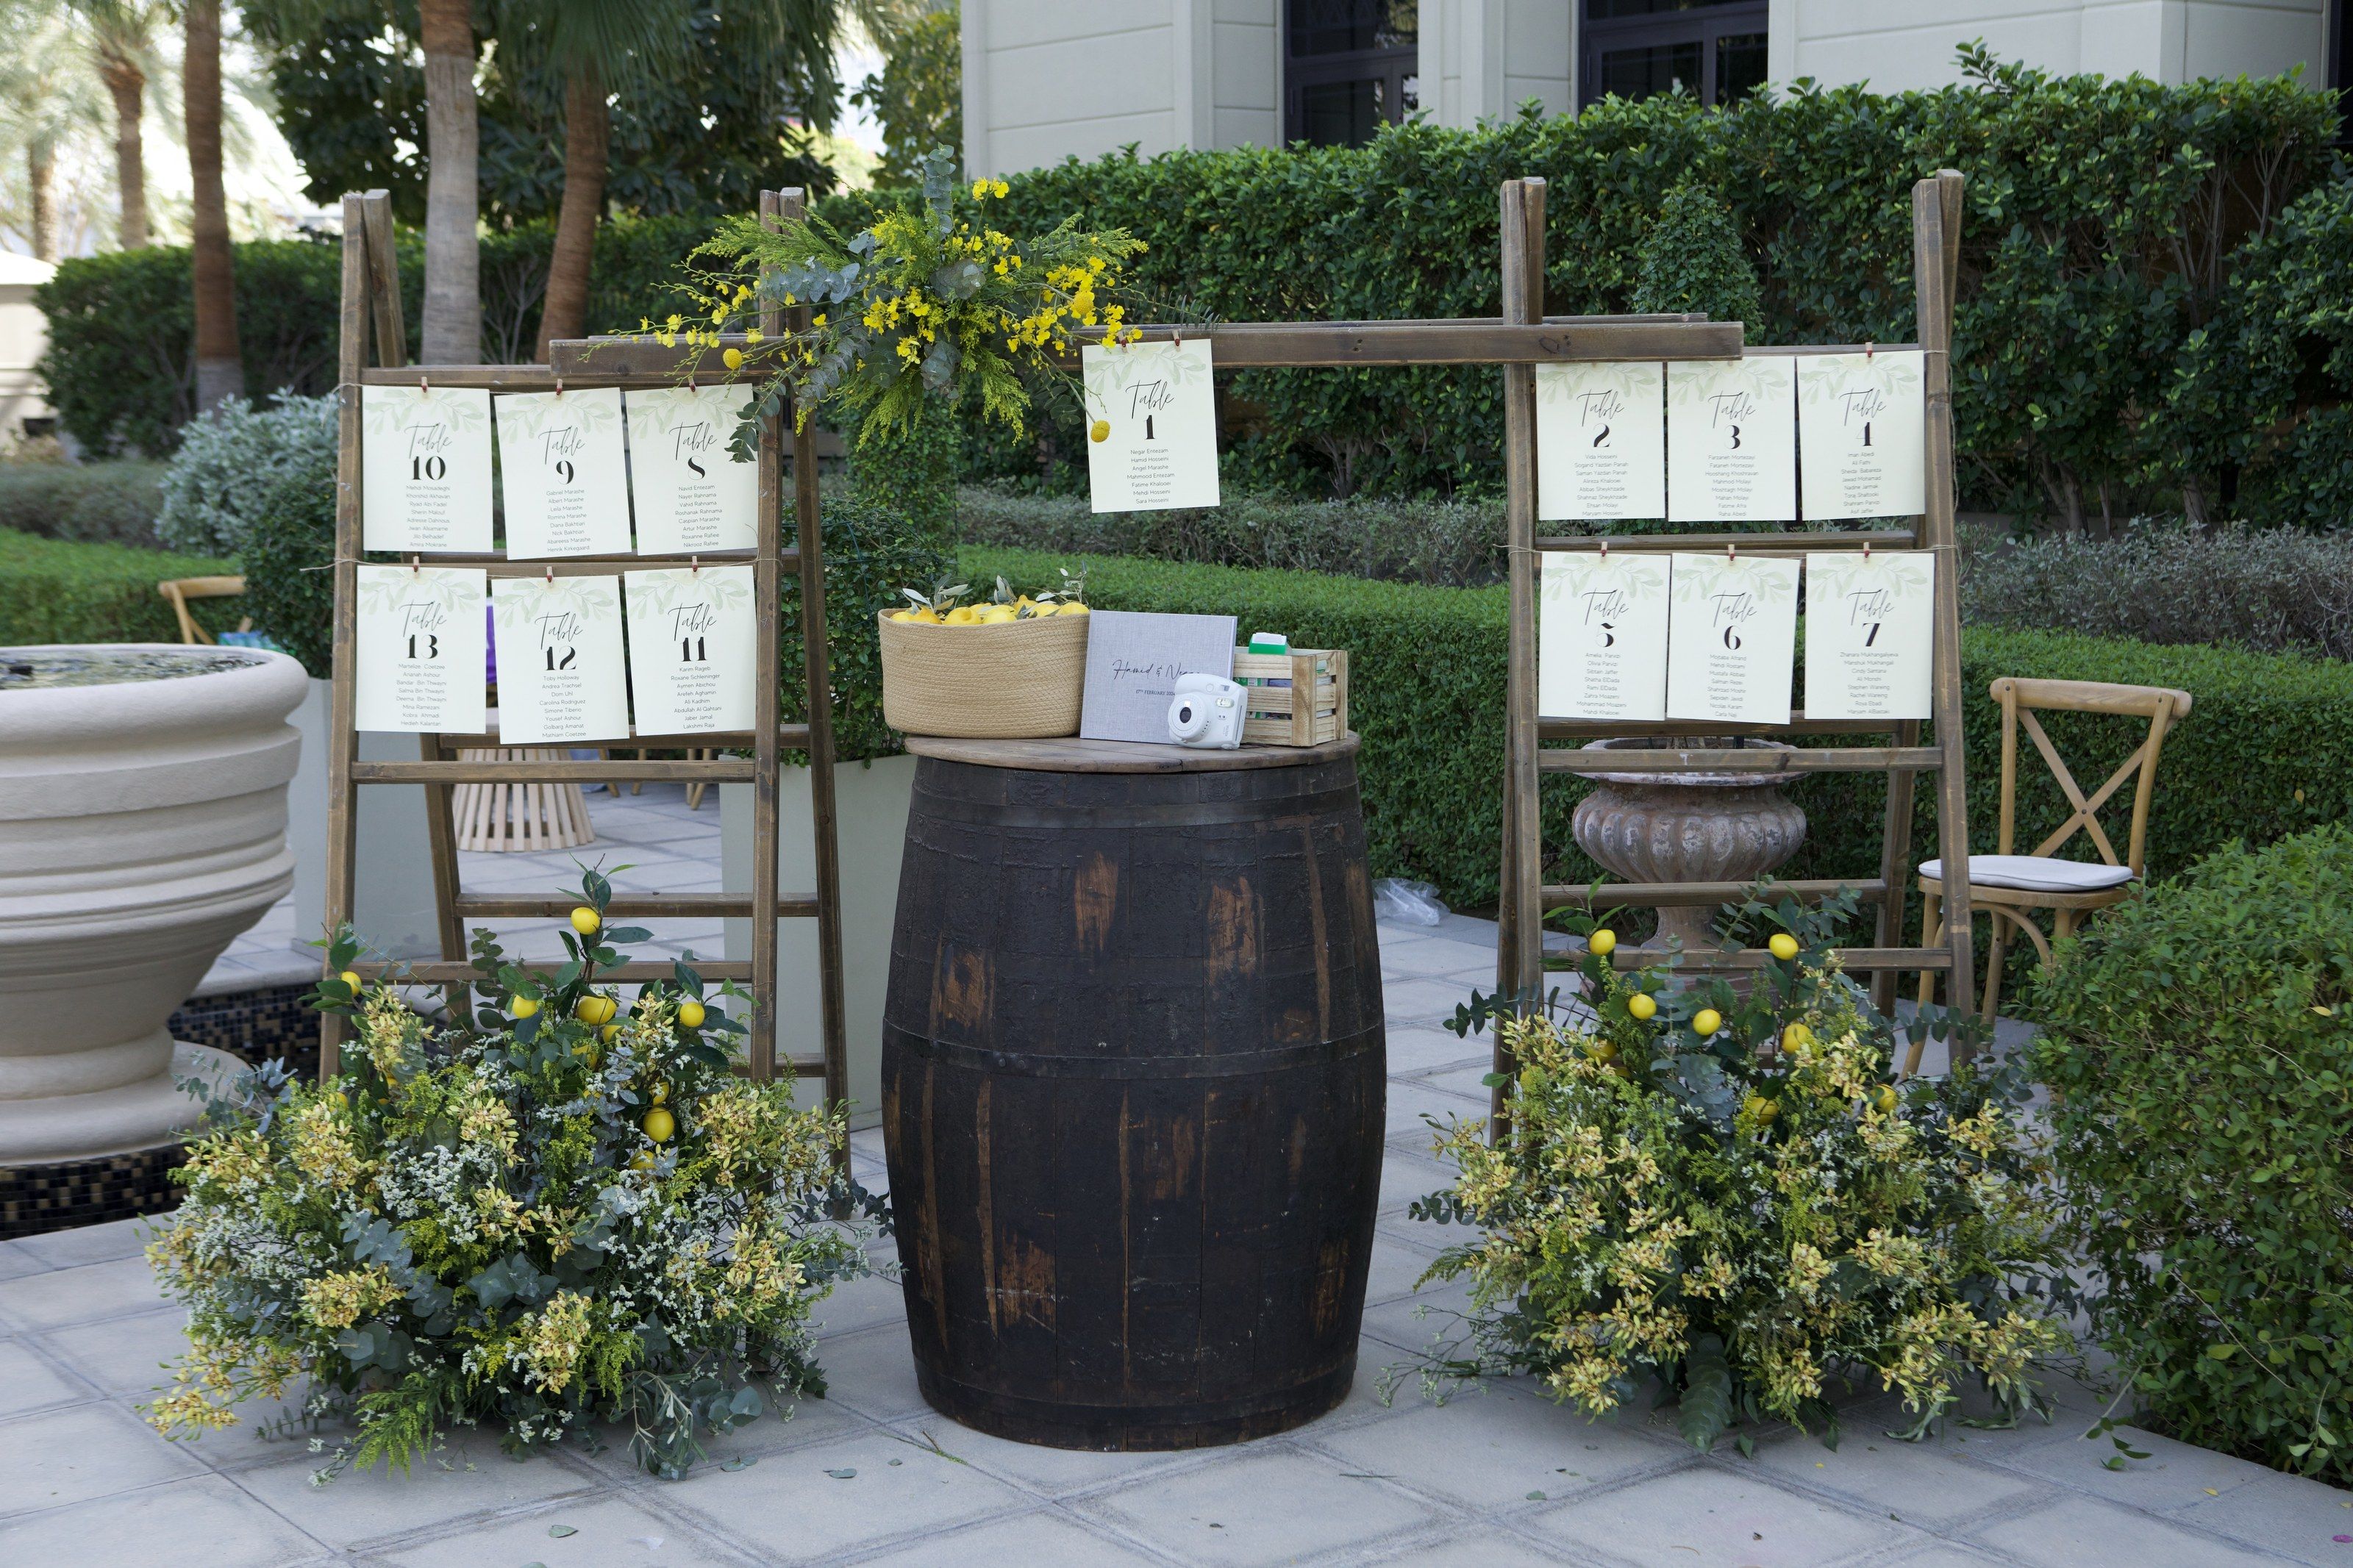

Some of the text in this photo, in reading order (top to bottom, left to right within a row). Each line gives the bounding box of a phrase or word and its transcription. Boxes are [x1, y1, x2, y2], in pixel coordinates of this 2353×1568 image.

[1125, 379, 1175, 419] Table
[1577, 387, 1625, 427] Table
[1707, 389, 1756, 429] Table
[1838, 387, 1887, 427] Table
[404, 422, 452, 459] Table
[668, 420, 718, 460] Table
[1143, 415, 1155, 440] 1
[1593, 423, 1611, 448] 2
[1725, 425, 1740, 450] 3
[1855, 422, 1874, 446] 4
[538, 425, 586, 465] Table
[412, 456, 446, 482] 10
[555, 459, 574, 484] 9
[688, 455, 706, 481] 8
[398, 601, 447, 637] Table
[1582, 589, 1629, 626] Table
[1710, 588, 1757, 628] Table
[1846, 587, 1895, 626] Table
[535, 611, 583, 649] Table
[668, 603, 717, 641] Table
[1596, 622, 1614, 648] 5
[1862, 623, 1881, 647] 7
[408, 634, 438, 659] 13
[681, 636, 707, 662] 11
[1724, 625, 1741, 650] 6
[545, 645, 577, 672] 12
[1112, 659, 1154, 680] Hamid
